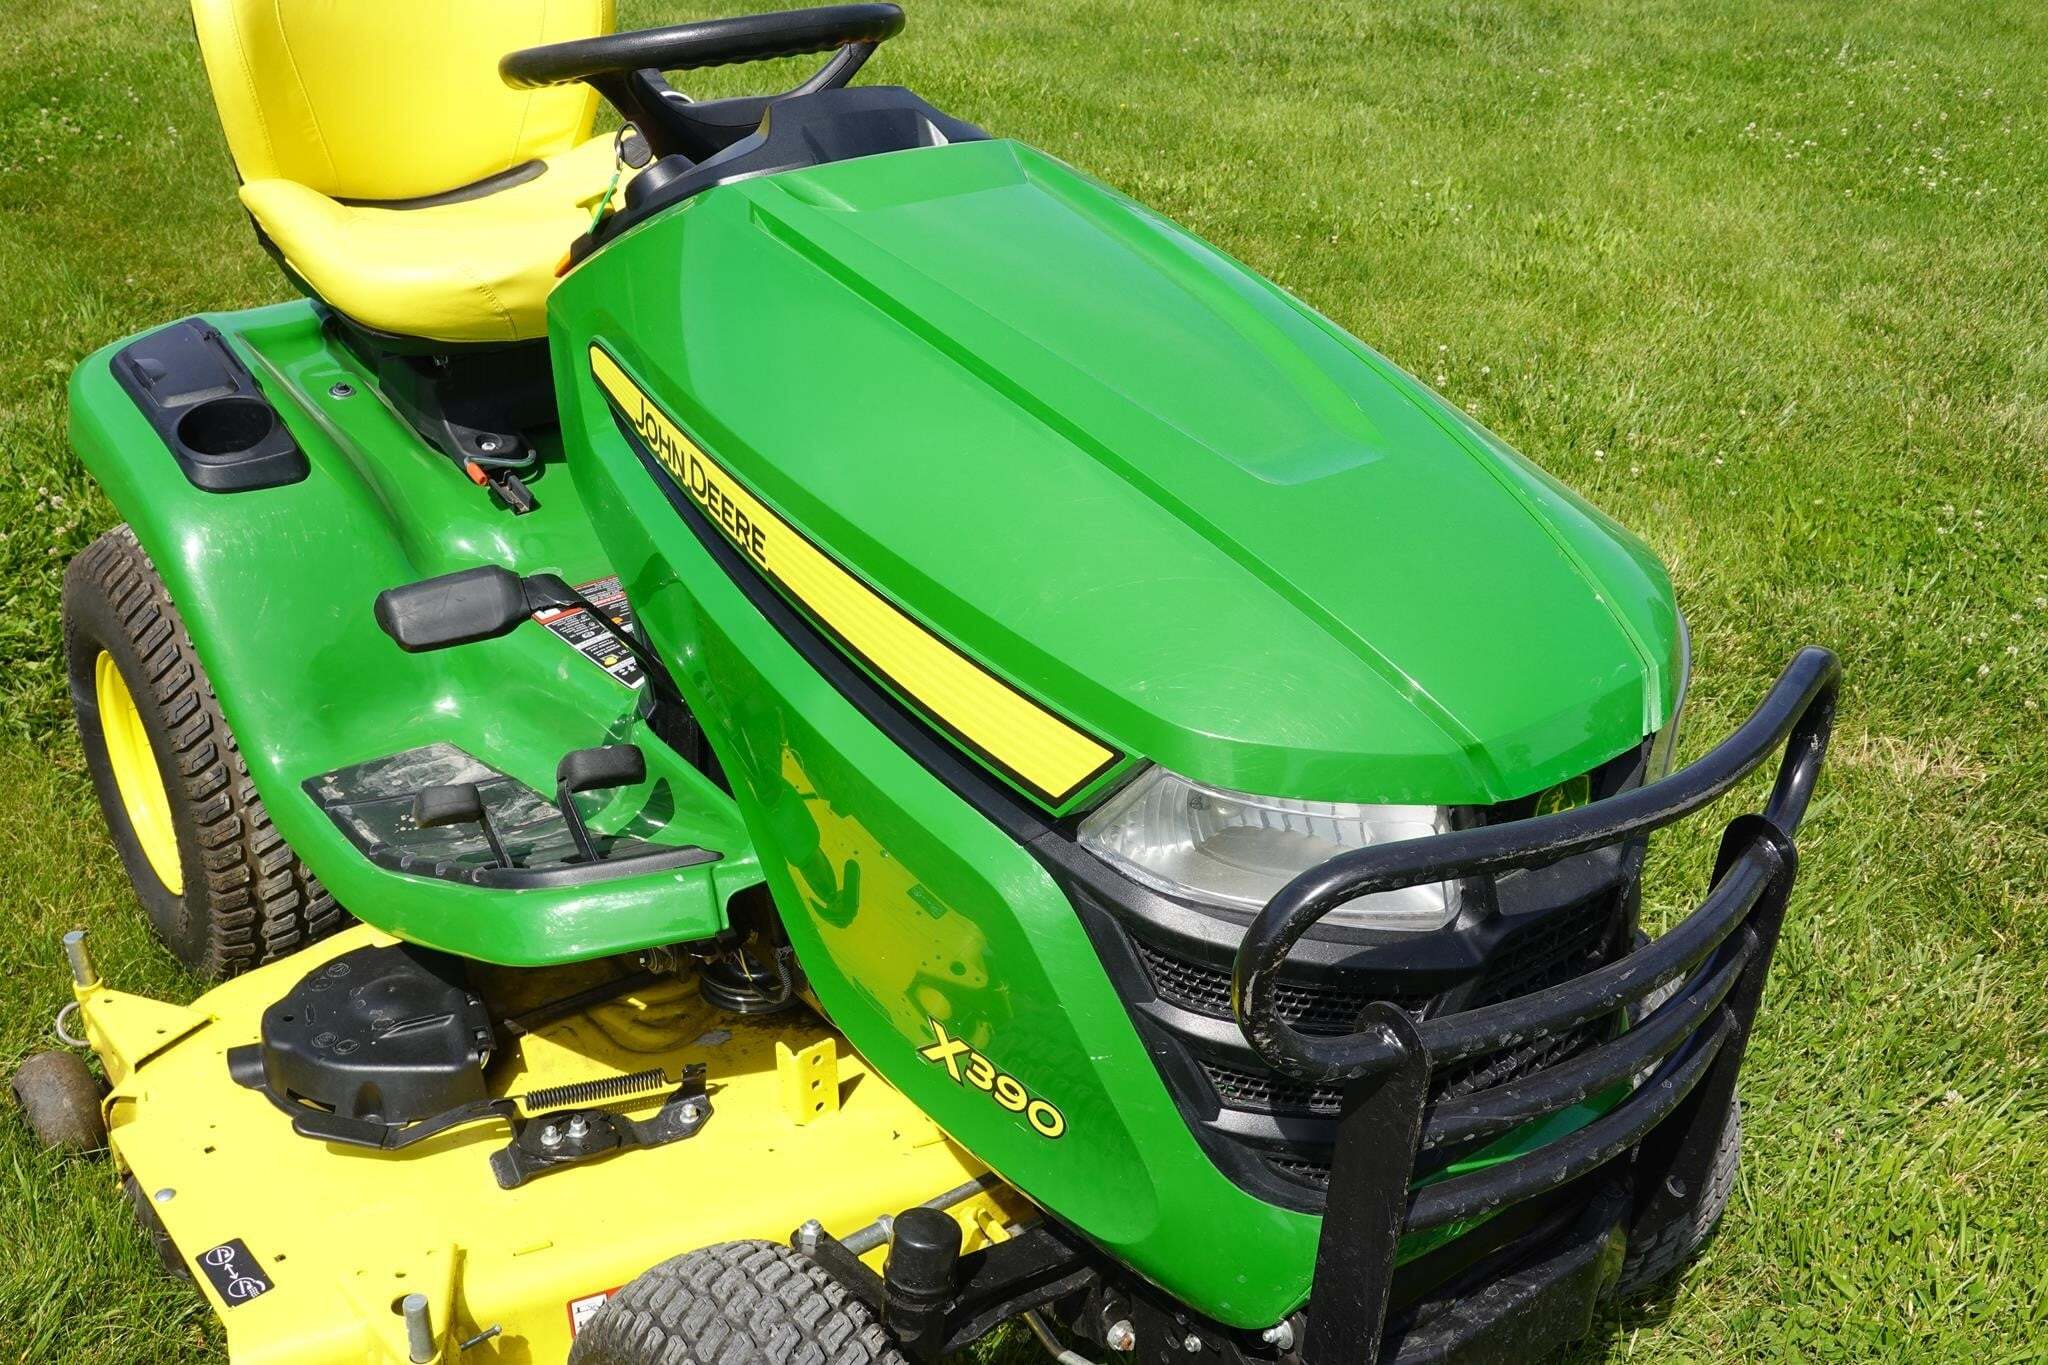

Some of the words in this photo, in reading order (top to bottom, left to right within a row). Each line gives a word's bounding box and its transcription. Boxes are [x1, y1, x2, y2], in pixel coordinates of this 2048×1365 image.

[635, 396, 686, 481] JOHN
[690, 453, 767, 564] DEERE
[916, 1015, 1067, 1140] X390
